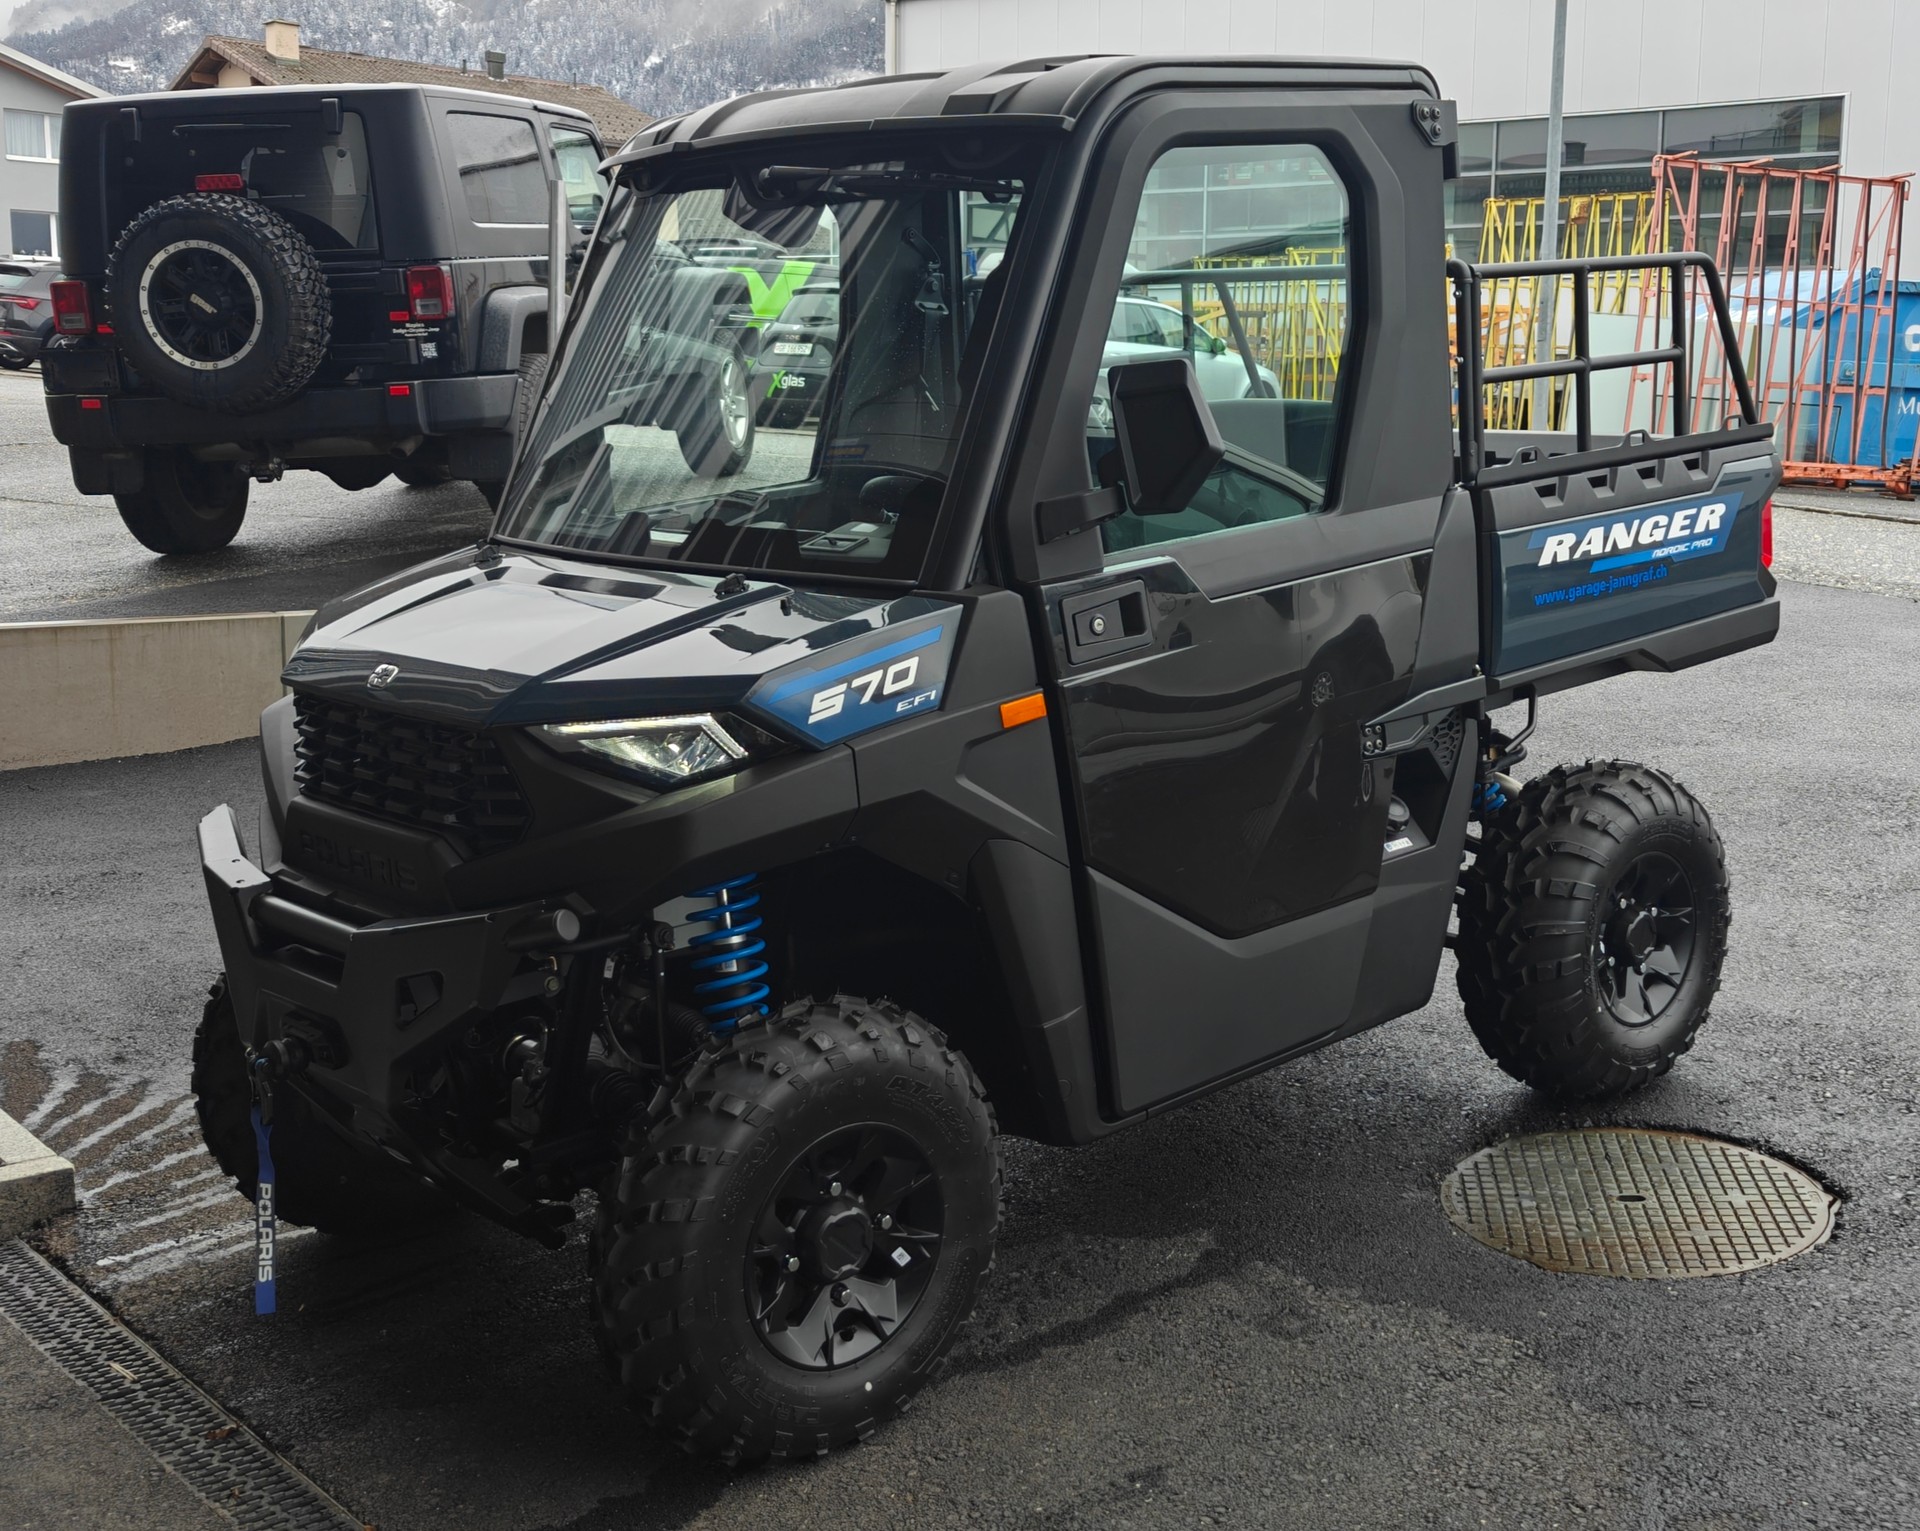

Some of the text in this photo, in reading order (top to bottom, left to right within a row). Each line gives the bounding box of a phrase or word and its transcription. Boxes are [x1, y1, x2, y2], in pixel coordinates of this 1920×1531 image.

[1537, 502, 1727, 567] RANGER
[1652, 537, 1714, 559] NORDIC PRO
[1534, 563, 1669, 606] www.garage-janngraf.ch
[896, 690, 937, 713] EFI
[300, 829, 419, 891] POLARIS
[258, 1182, 274, 1283] POLARIS
